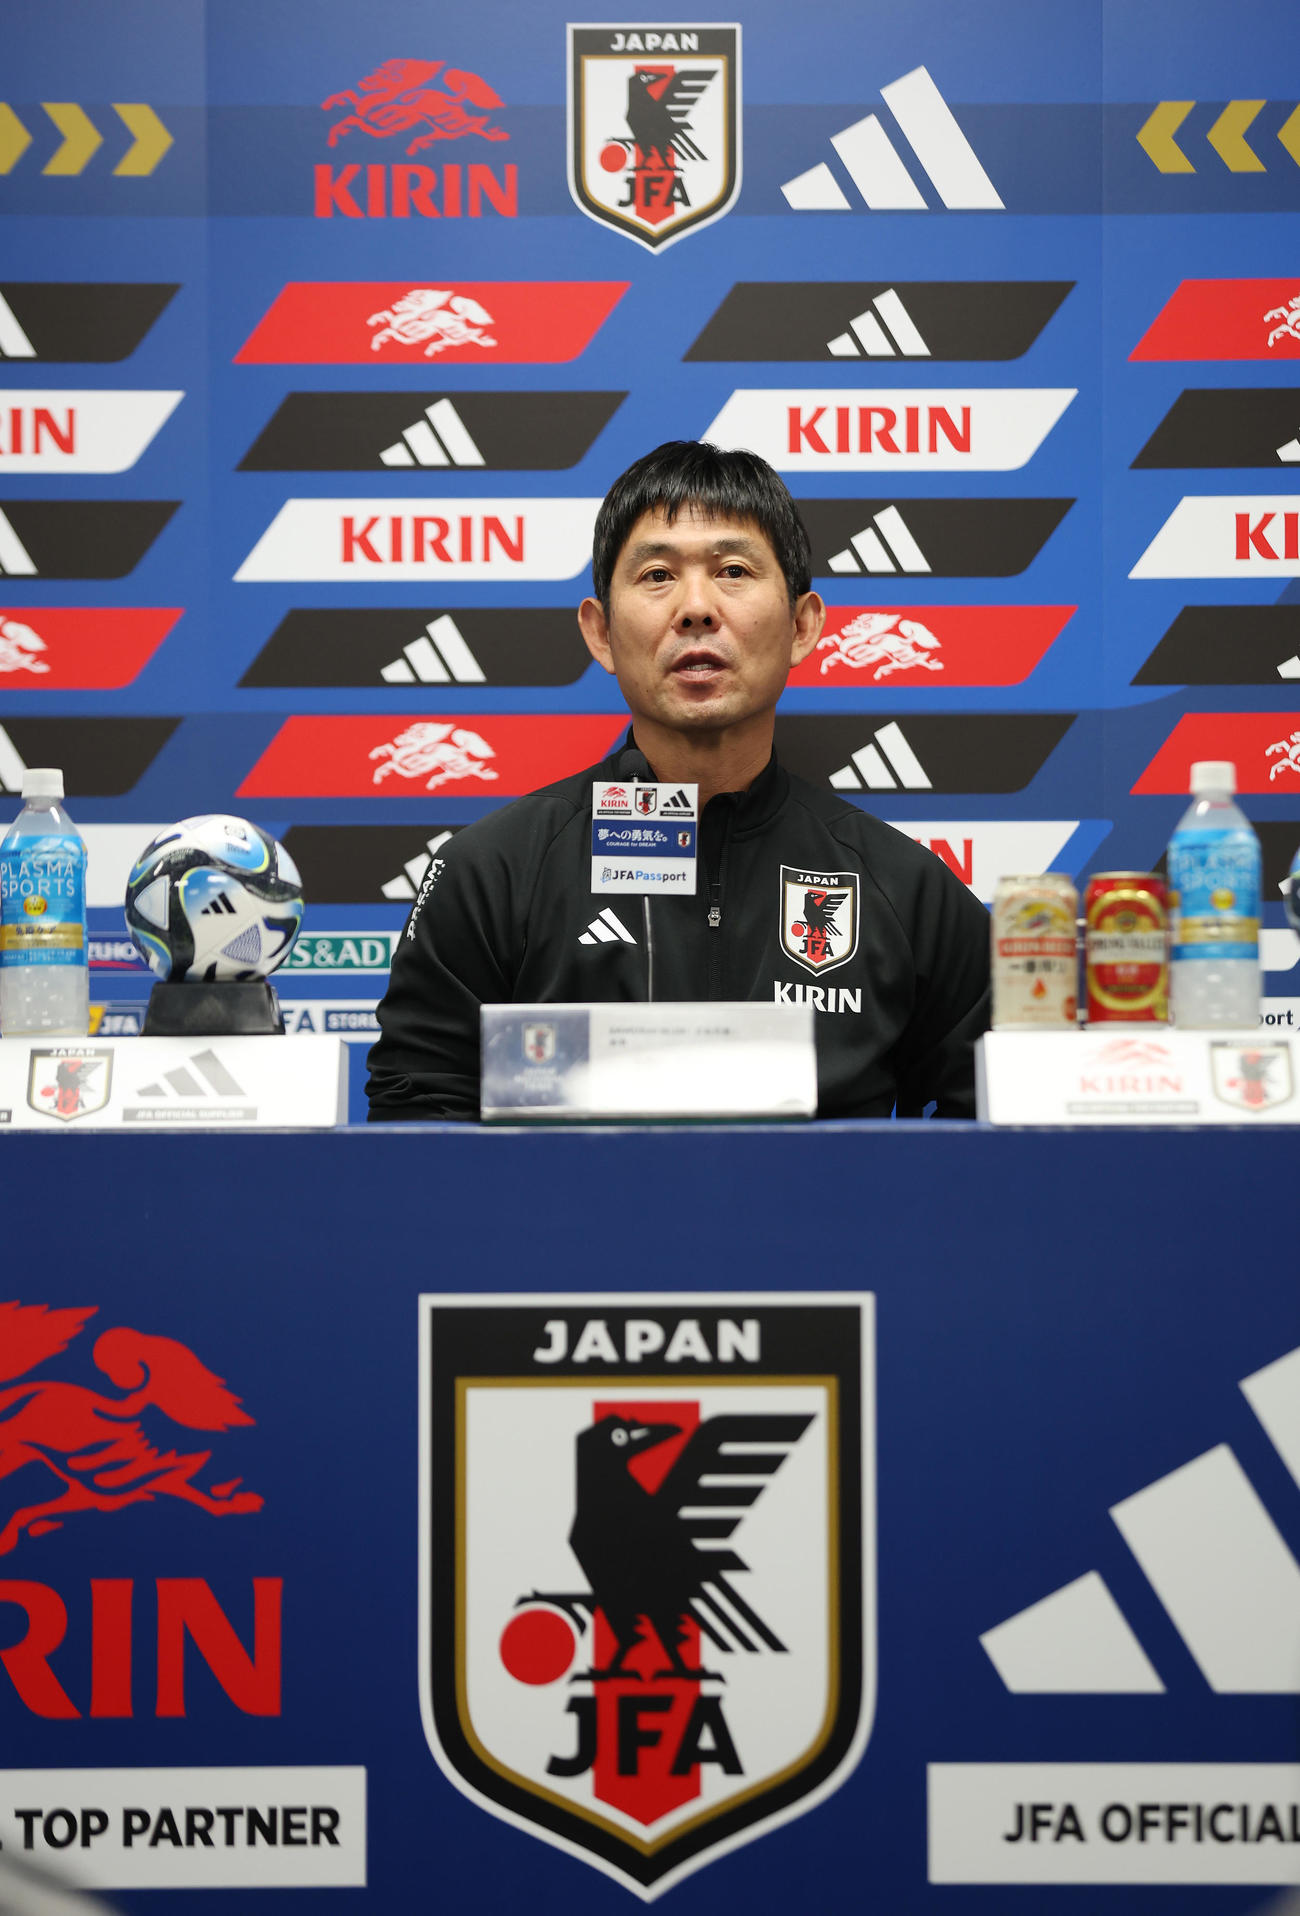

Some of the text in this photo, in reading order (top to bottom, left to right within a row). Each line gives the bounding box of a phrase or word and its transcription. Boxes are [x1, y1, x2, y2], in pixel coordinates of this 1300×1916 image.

[610, 33, 699, 51] JAPAN
[314, 163, 518, 219] KIRIN
[617, 176, 692, 207] JFA
[0, 408, 75, 454] IN
[787, 406, 971, 454] KIRIN
[341, 515, 525, 562] KIRIN
[1235, 512, 1299, 560] KI
[600, 799, 629, 808] KIRIN
[0, 861, 75, 880] PLASMA
[797, 874, 839, 886] JAPAN
[1, 878, 76, 899] SPORTS
[284, 939, 387, 967] S&AD
[798, 940, 835, 957] JFA
[773, 980, 862, 1014] KIRIN
[100, 1015, 139, 1034] JFA
[533, 1319, 760, 1363] JAPAN
[545, 1693, 745, 1778] JFA
[15, 1806, 341, 1850] TOP PARTNER
[1003, 1803, 1086, 1843] JFA
